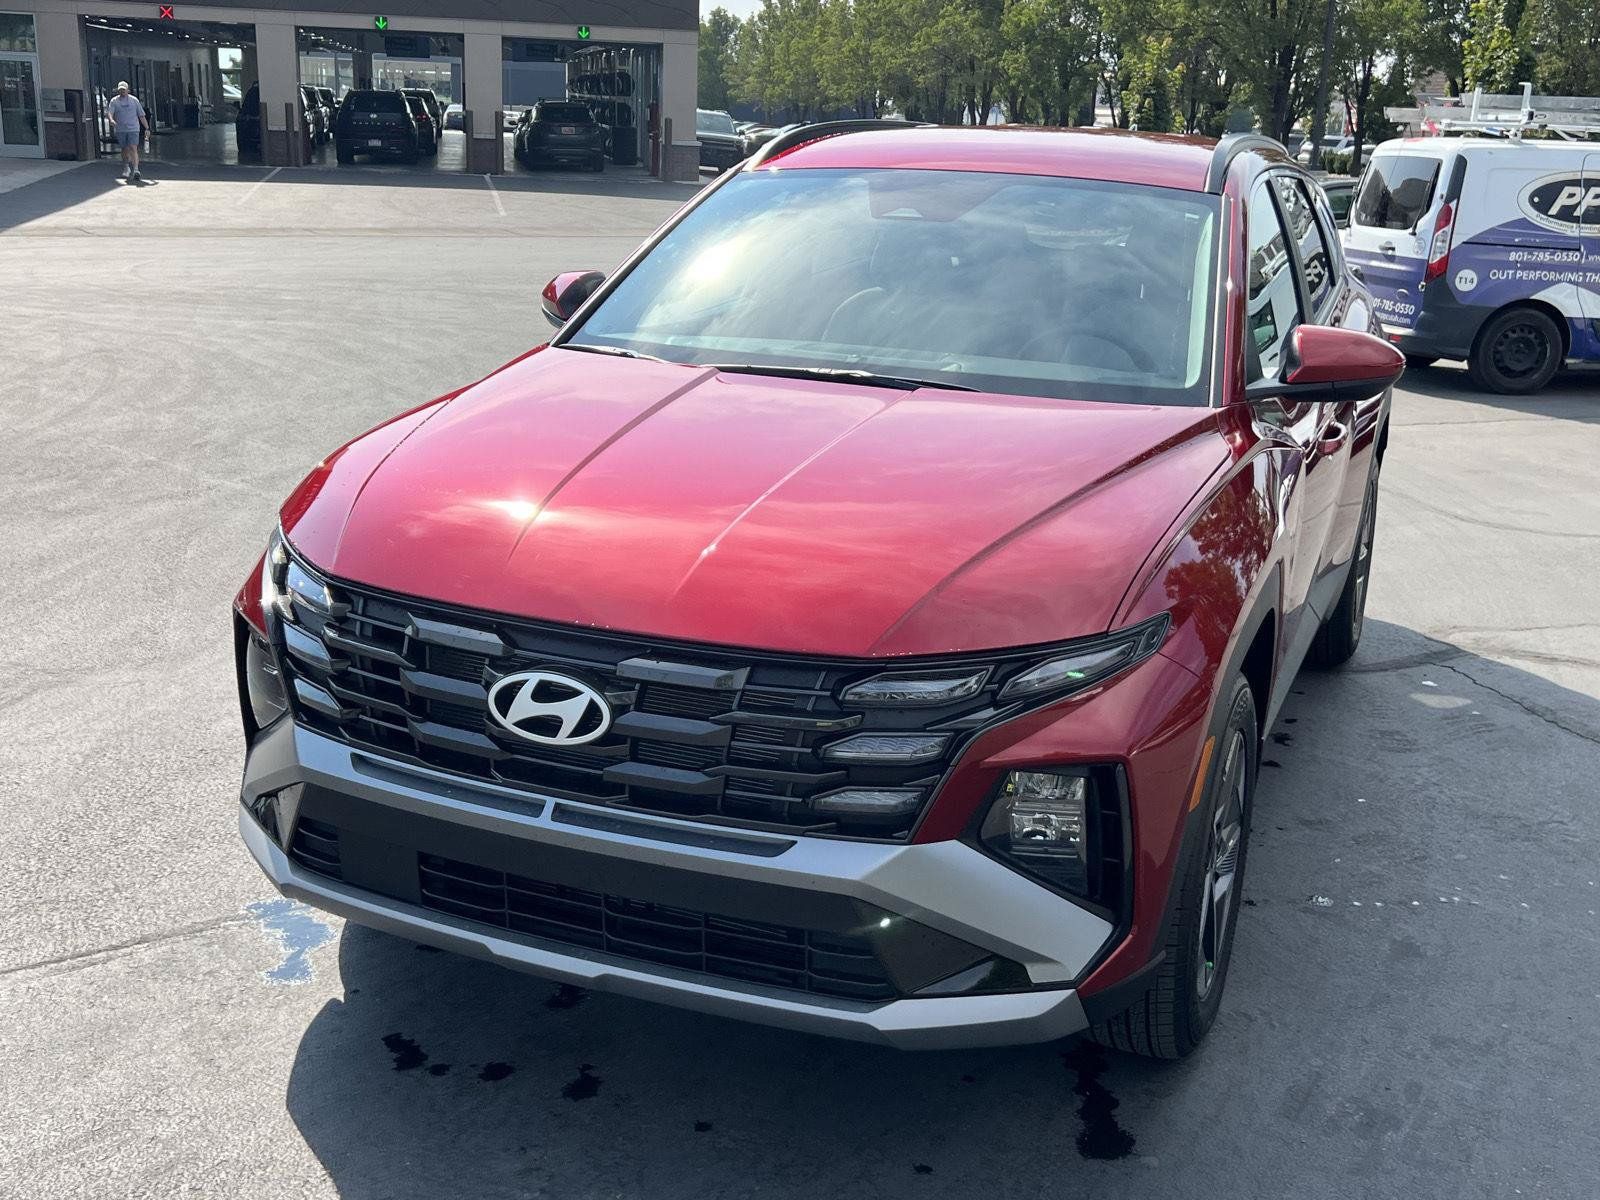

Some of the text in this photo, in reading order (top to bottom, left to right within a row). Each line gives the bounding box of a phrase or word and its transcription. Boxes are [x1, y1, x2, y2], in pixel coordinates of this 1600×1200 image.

[1536, 213, 1575, 230] Performance
[1509, 251, 1580, 261] 801-785-0530
[1459, 276, 1474, 285] T14
[1489, 269, 1600, 283] OUT PERFORMING TH
[1372, 297, 1415, 315] 01-785-0530
